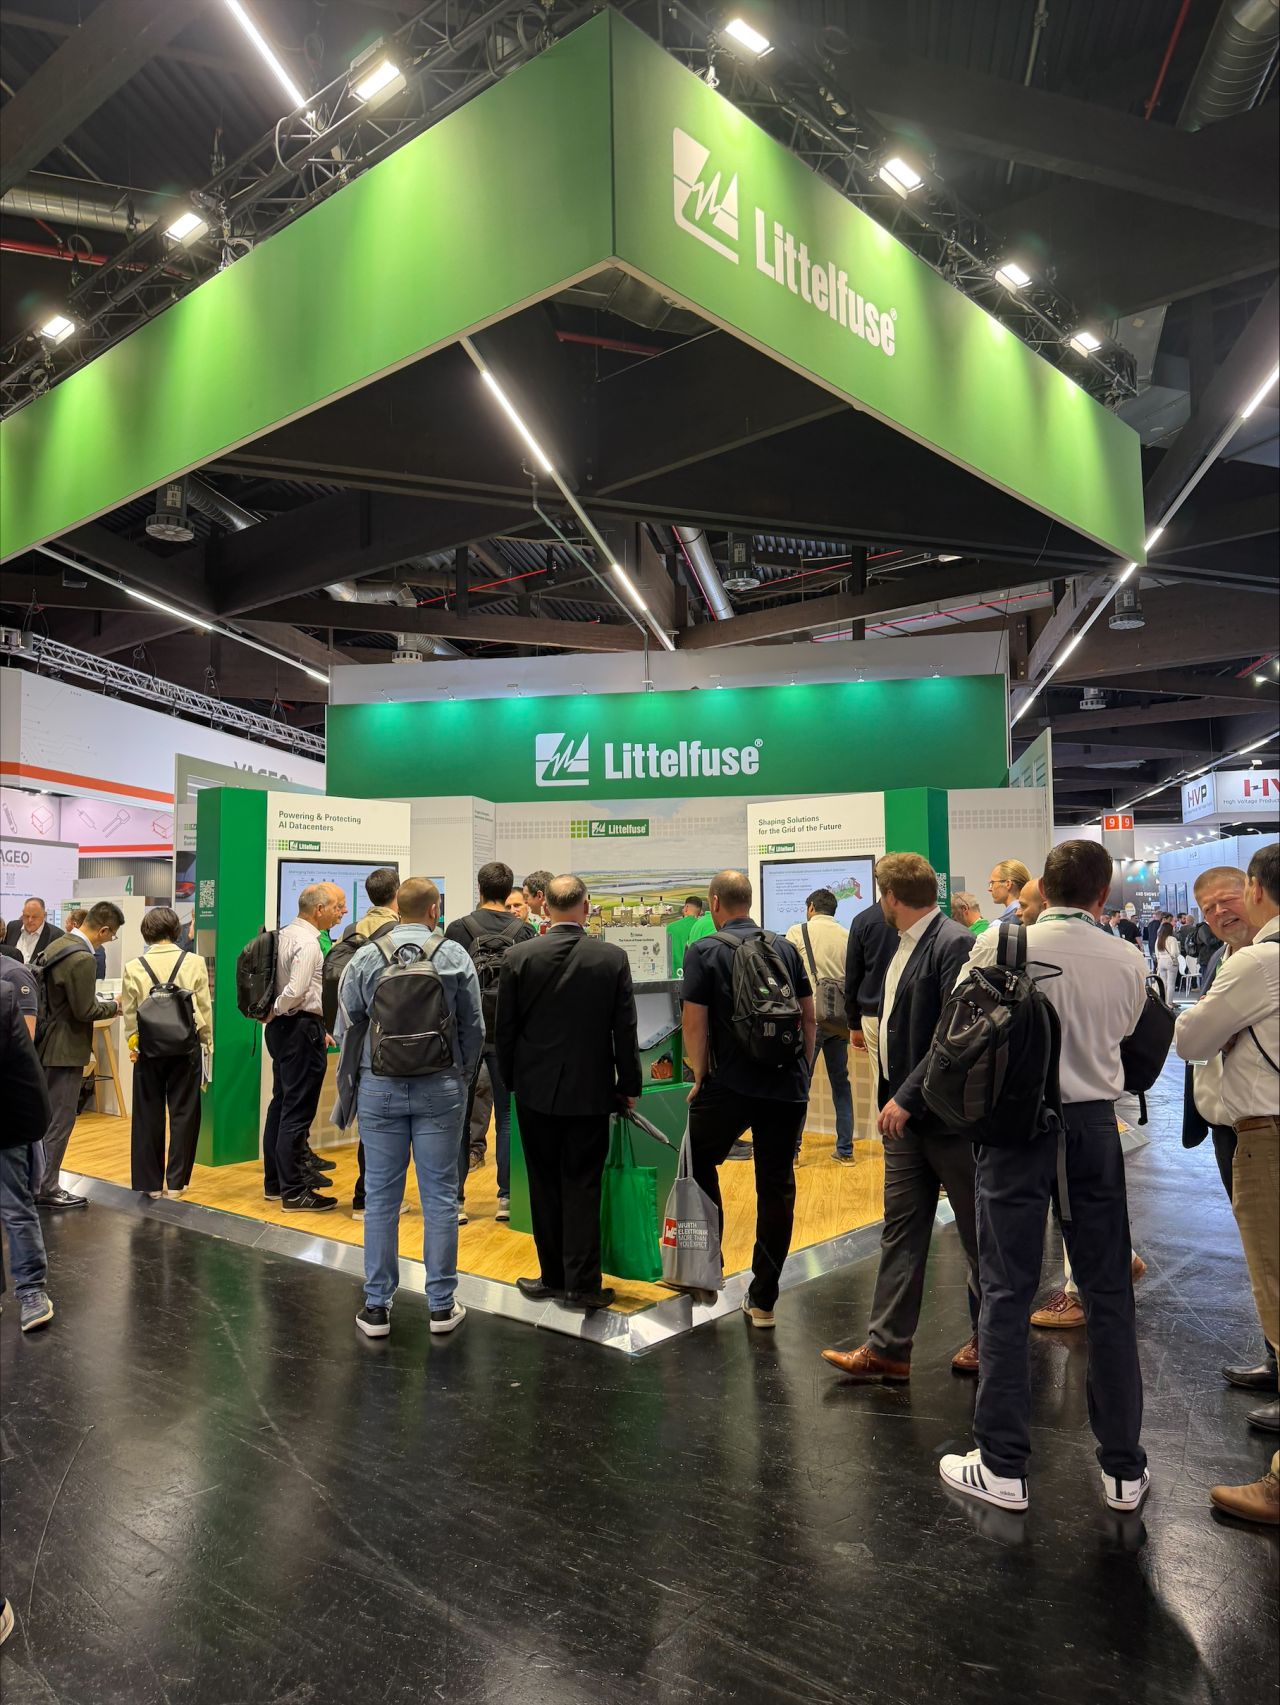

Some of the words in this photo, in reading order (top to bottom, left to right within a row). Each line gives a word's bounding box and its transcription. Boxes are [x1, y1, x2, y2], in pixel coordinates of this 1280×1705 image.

[1187, 784, 1207, 808] HVP
[278, 810, 315, 822] Powering
[316, 812, 323, 821] &
[325, 814, 361, 824] Protecting
[758, 817, 786, 827] Shaping
[787, 816, 819, 824] Solutions
[1109, 817, 1116, 828] 9
[1124, 817, 1130, 827] 9
[278, 821, 287, 829] AI
[289, 821, 334, 832] Datacenters
[608, 823, 647, 834] Littelfuse
[781, 826, 796, 834] Grid
[797, 825, 805, 833] of
[806, 824, 818, 832] the
[819, 822, 842, 831] Future
[124, 876, 133, 896] 4
[763, 1022, 776, 1037] 10
